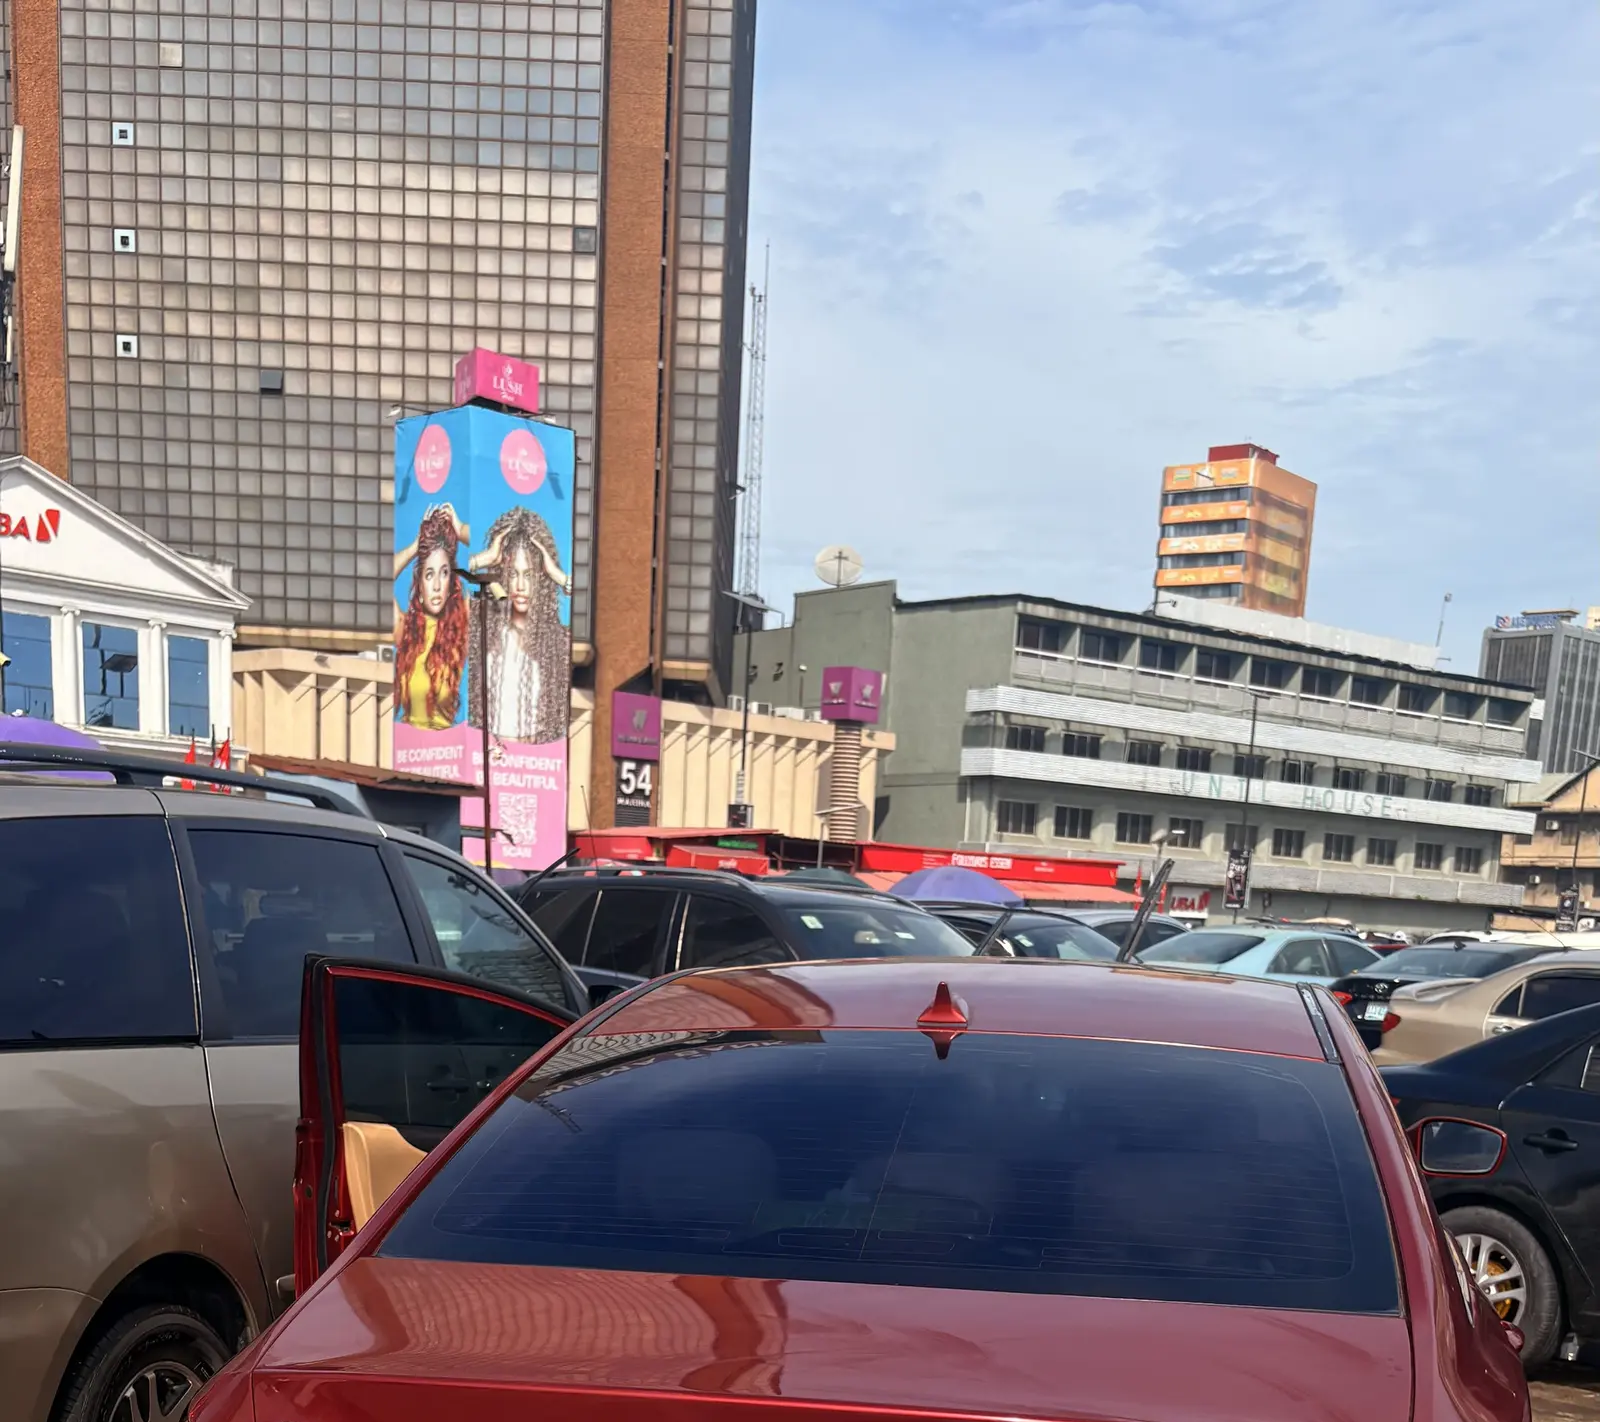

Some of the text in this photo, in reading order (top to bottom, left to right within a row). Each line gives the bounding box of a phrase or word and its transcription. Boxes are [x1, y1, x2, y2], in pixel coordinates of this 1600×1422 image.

[492, 375, 523, 397] LUSH
[408, 745, 465, 762] CONFIDENT
[489, 753, 563, 772] CONFIDENT
[493, 772, 559, 791] BEAUTIFUL
[620, 760, 652, 796] 54
[1303, 786, 1394, 818] HOUSE
[502, 846, 532, 858] SCAN
